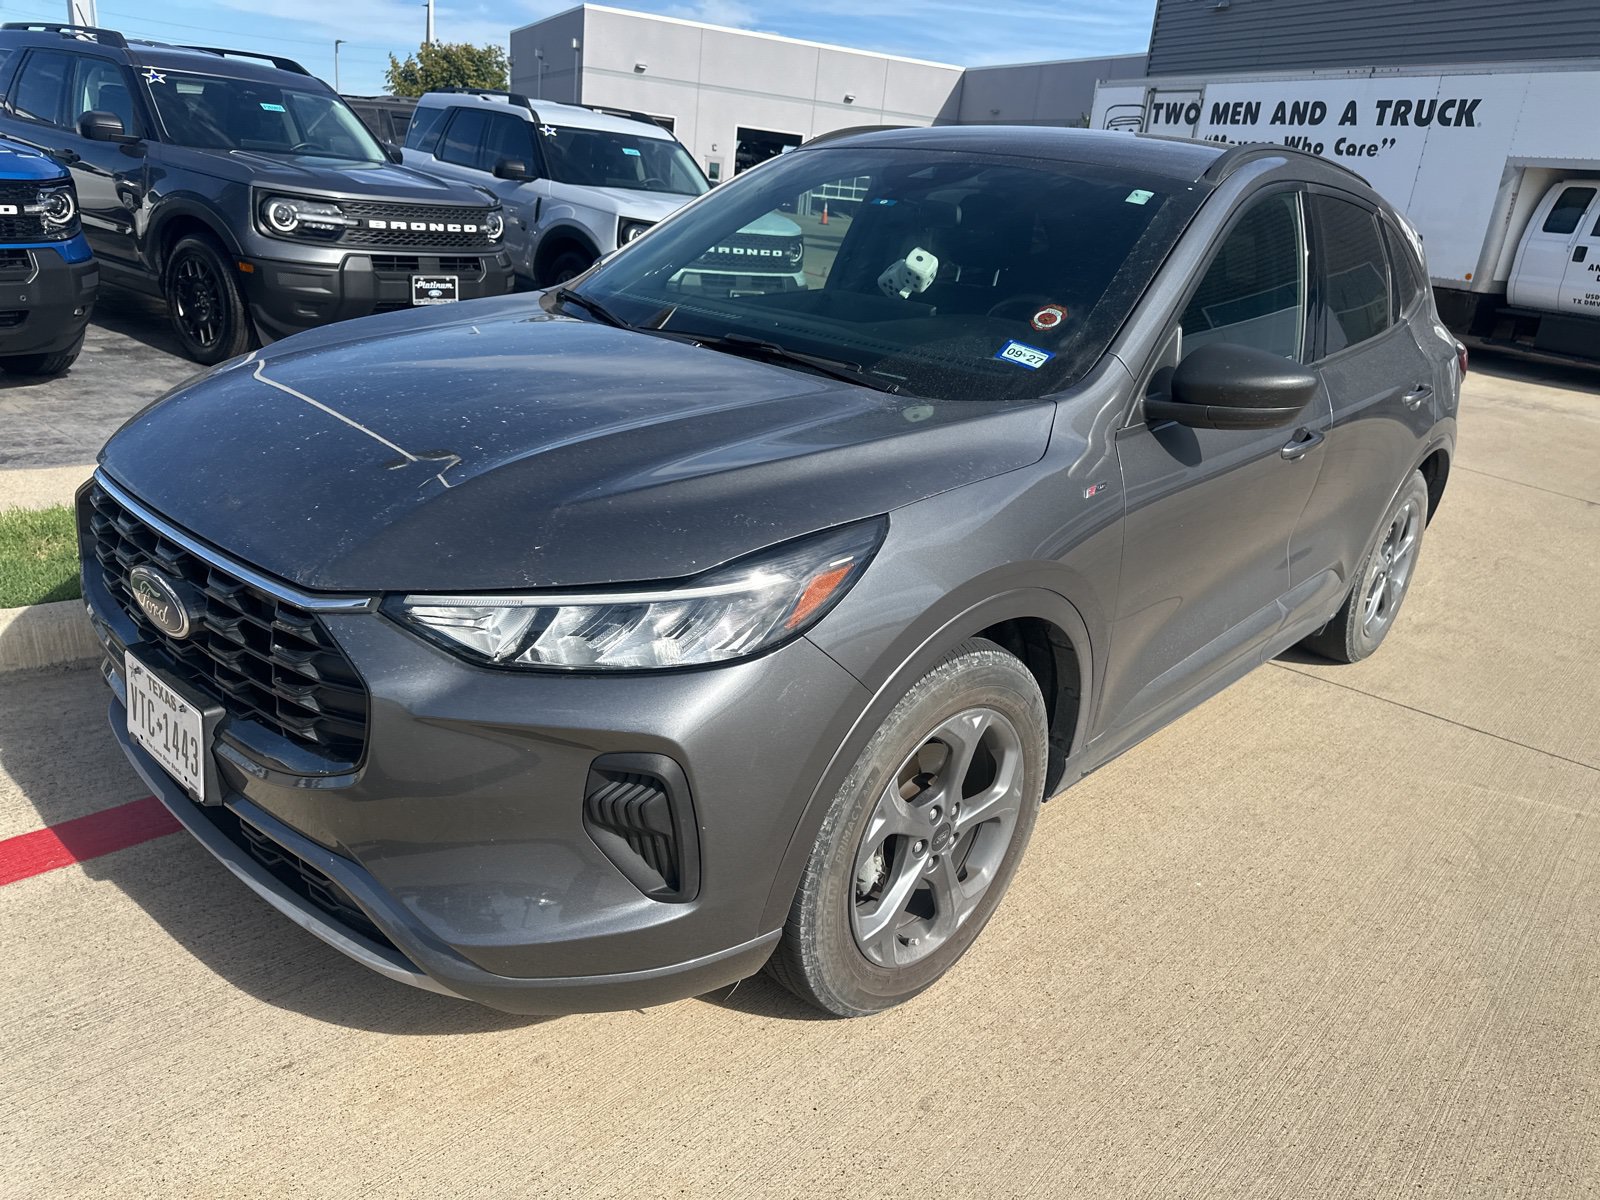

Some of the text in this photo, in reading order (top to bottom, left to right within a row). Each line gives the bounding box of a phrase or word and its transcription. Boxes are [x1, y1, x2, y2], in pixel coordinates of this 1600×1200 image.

[1153, 102, 1201, 125] TWO
[1209, 101, 1262, 126] MEN
[1270, 101, 1327, 126] AND
[1338, 100, 1357, 126] A
[1284, 136, 1325, 155] Who
[368, 219, 477, 232] BRONCO
[415, 281, 454, 290] Platinum
[137, 580, 169, 625] Ford
[146, 673, 177, 712] TEXAS
